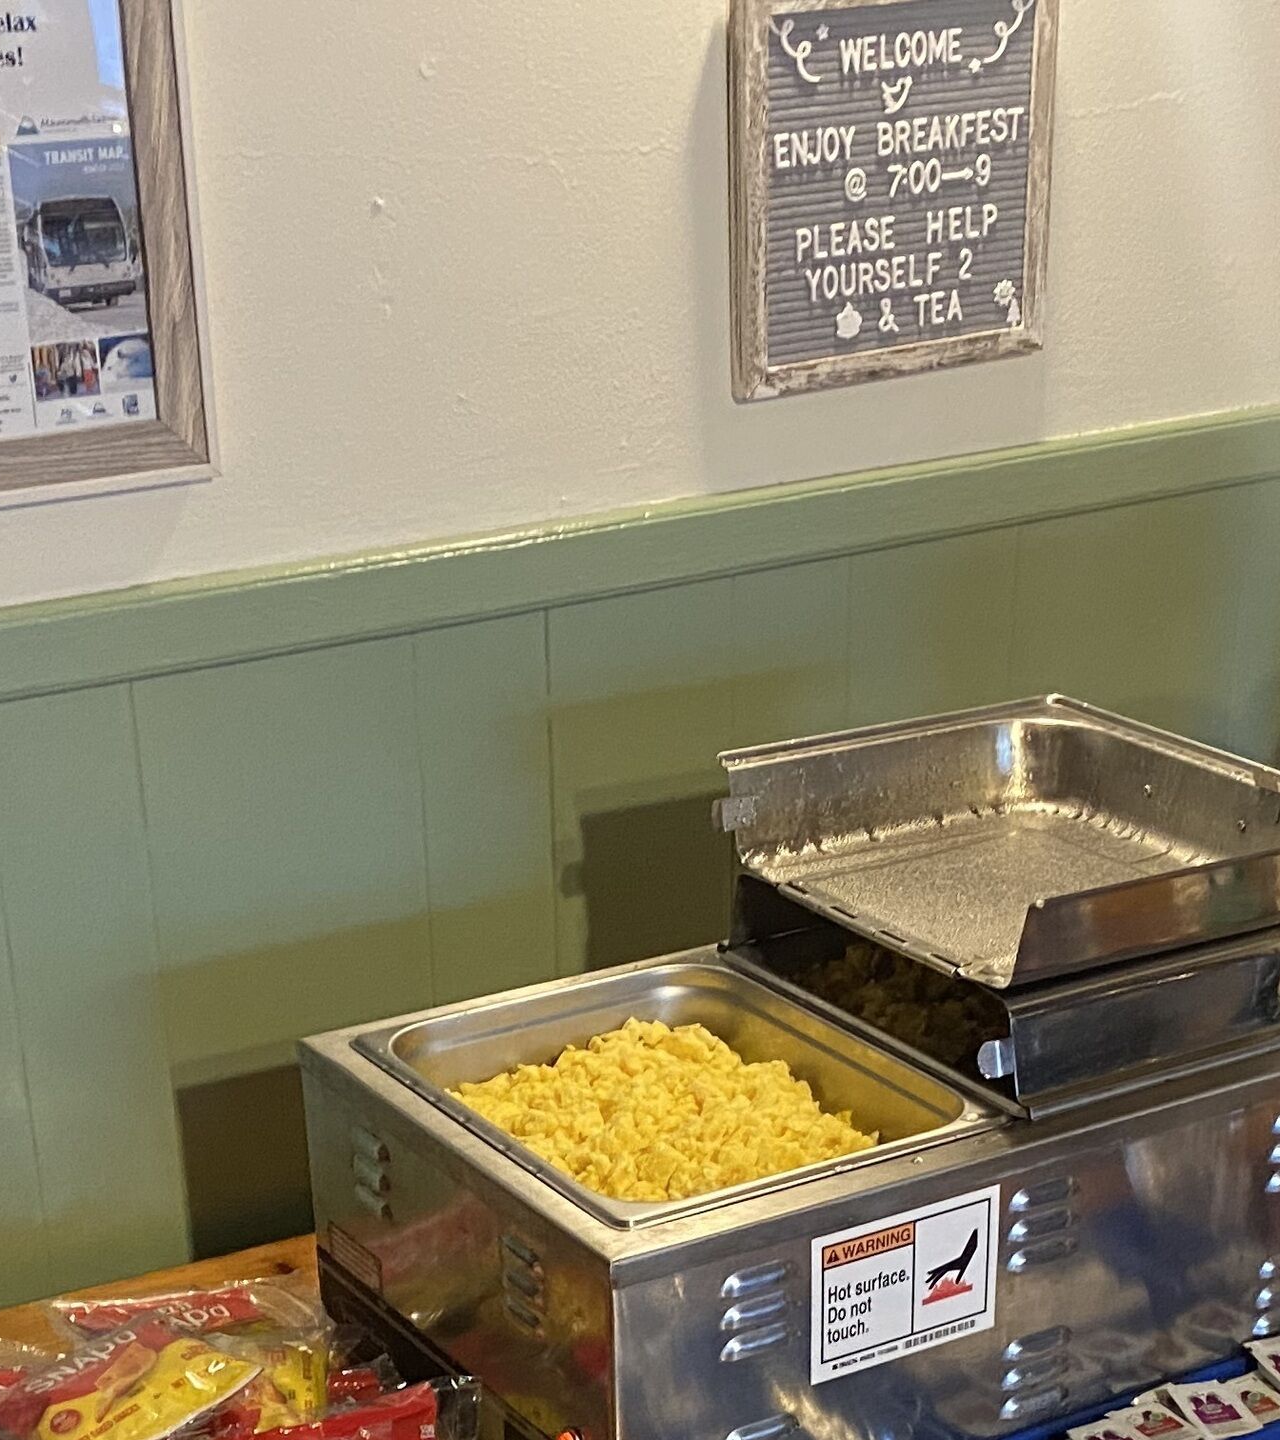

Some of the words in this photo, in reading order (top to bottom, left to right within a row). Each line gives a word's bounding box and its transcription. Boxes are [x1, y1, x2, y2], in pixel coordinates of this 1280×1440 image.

[840, 28, 963, 75] WELCOME
[45, 150, 95, 166] TRANSIT
[98, 146, 124, 160] MAP
[773, 126, 856, 169] ENJOY
[877, 107, 1024, 156] BREAKFEST
[844, 167, 868, 202] @
[796, 215, 896, 262] PLEASE
[926, 203, 999, 245] HELP
[805, 252, 943, 302] YOURSELF
[959, 248, 973, 281] 2
[878, 298, 900, 333] &
[913, 289, 963, 326] TEA
[841, 1227, 911, 1259] WARNING
[827, 1283, 852, 1305] Hot
[855, 1267, 911, 1296] surface.
[827, 1306, 847, 1324] Do
[850, 1297, 872, 1320] not
[826, 1319, 870, 1344] touch.
